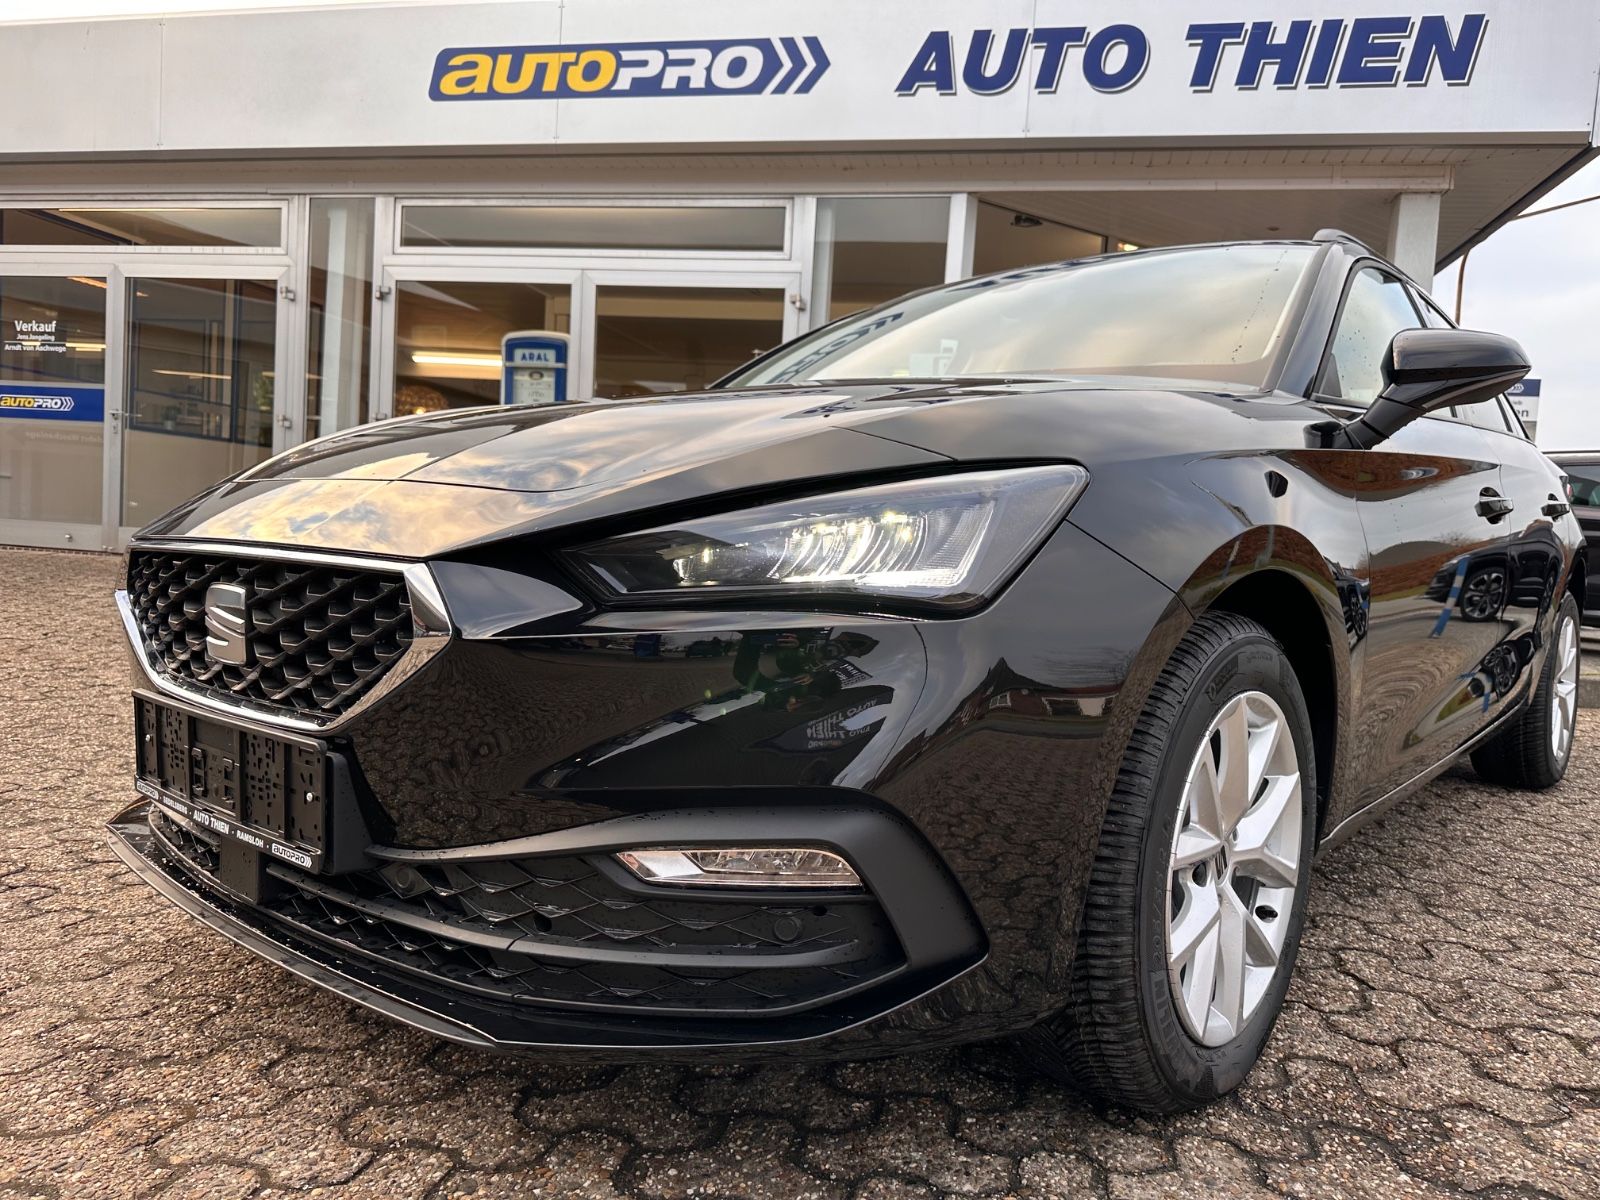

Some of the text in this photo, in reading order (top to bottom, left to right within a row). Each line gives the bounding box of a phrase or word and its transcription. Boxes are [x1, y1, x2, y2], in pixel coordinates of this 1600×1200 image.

[894, 13, 1487, 96] AUTO THIEN
[14, 320, 57, 332] Verkauf
[521, 352, 550, 362] ARAL
[193, 810, 210, 826] AUTO
[210, 818, 230, 835] THIEN
[236, 830, 264, 849] RAMSLOH
